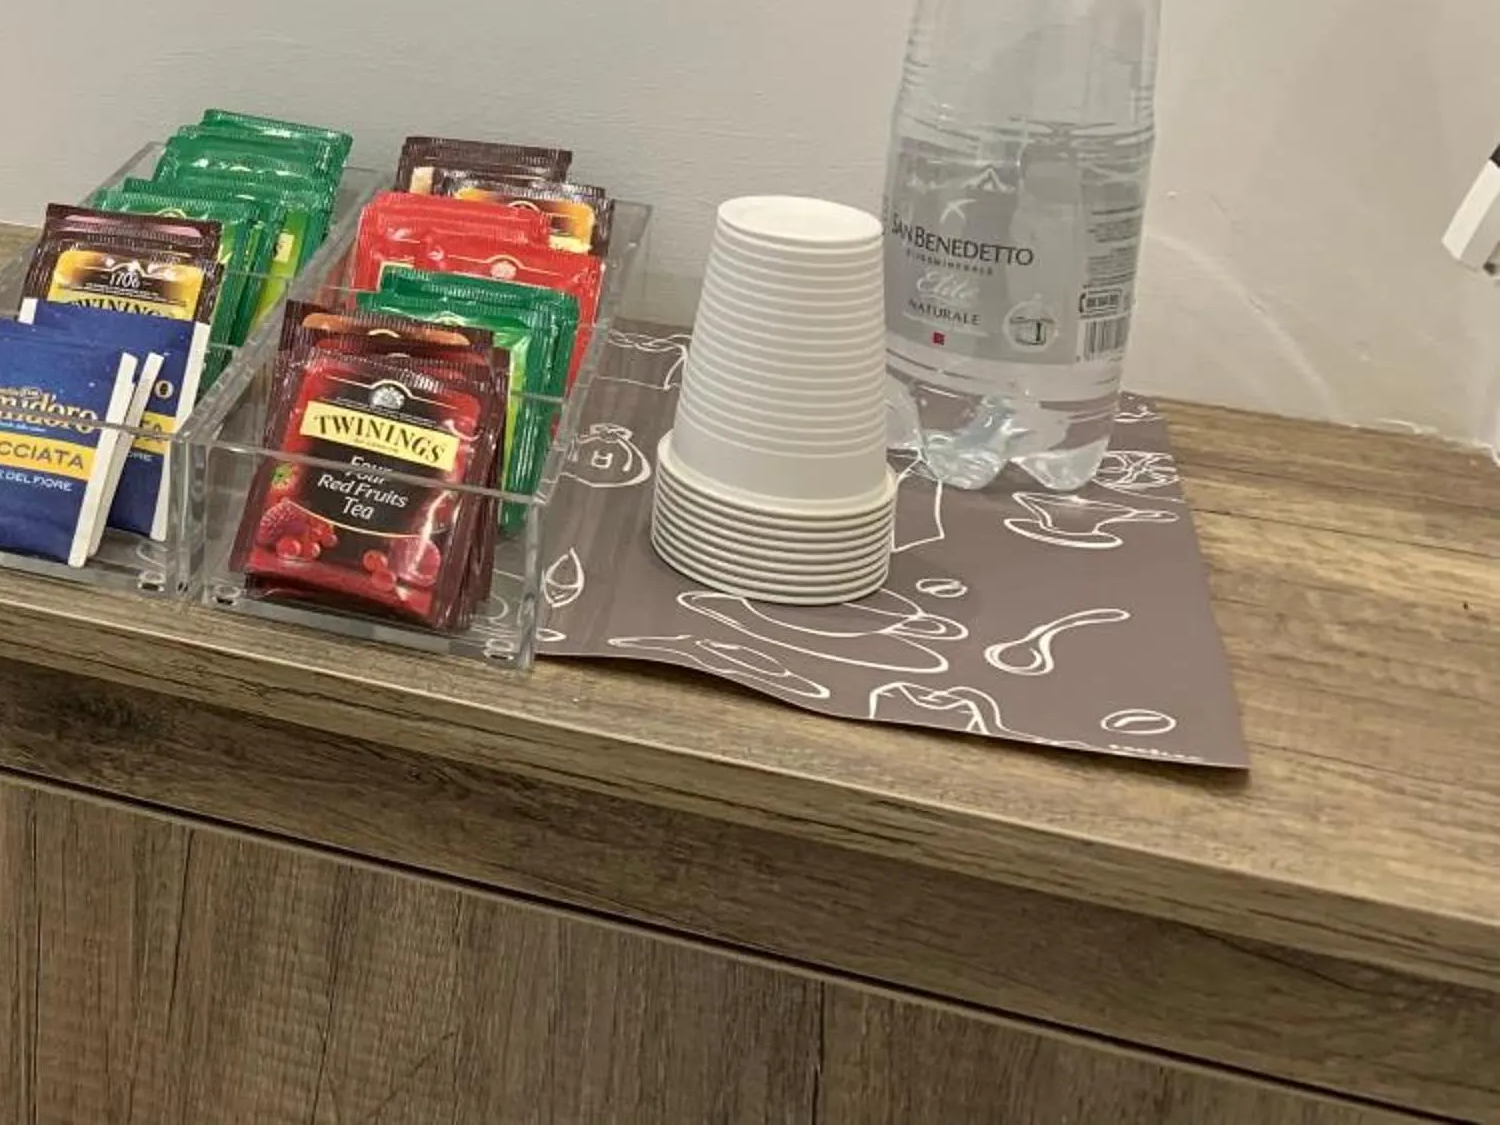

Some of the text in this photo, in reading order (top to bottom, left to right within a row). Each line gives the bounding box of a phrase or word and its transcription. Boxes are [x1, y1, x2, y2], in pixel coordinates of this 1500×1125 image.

[908, 298, 981, 326] NATURALE
[314, 414, 445, 463] TWININGS
[5, 470, 31, 484] DEL
[33, 475, 73, 492] FIORE
[318, 473, 408, 508] Red Fruits
[343, 496, 375, 520] Tea
